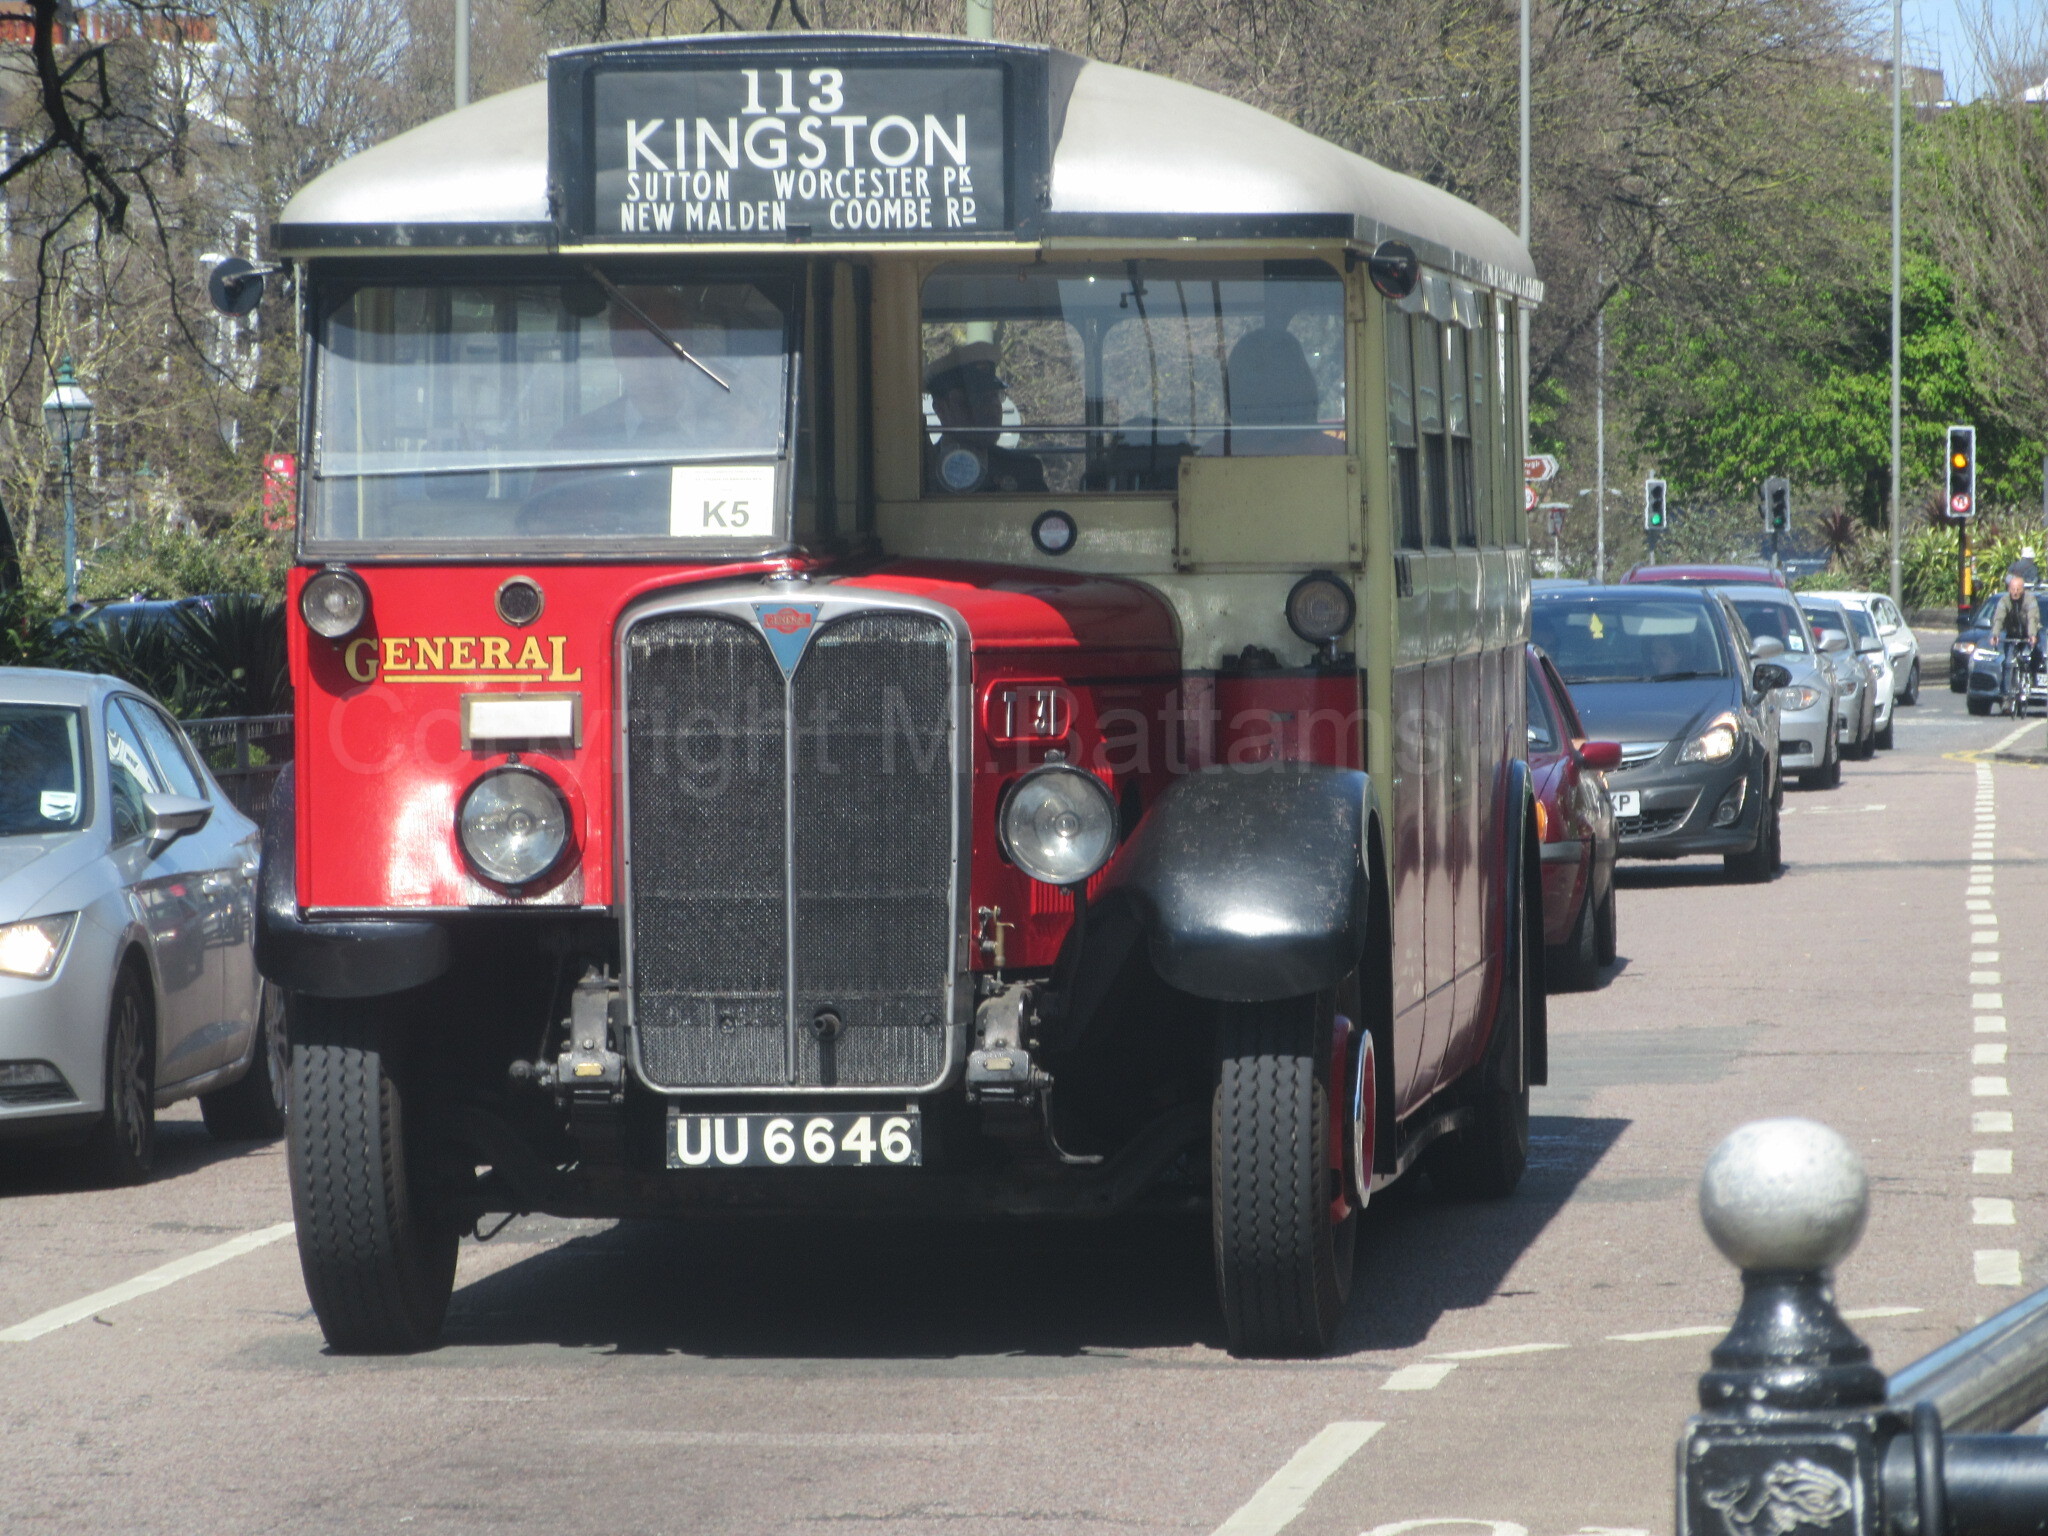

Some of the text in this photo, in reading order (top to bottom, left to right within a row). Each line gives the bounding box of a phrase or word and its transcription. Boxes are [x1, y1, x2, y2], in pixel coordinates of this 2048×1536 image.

[741, 67, 845, 116] 113
[626, 114, 968, 171] KINGSTON
[626, 170, 729, 201] SUTTON
[773, 166, 930, 200] WORCESTER
[620, 202, 675, 232] NEW
[685, 200, 786, 232] MALDEN
[829, 198, 932, 230] COOMBE
[702, 500, 750, 528] K5
[344, 635, 583, 684] GENERAL
[677, 1116, 912, 1165] UU 6646
